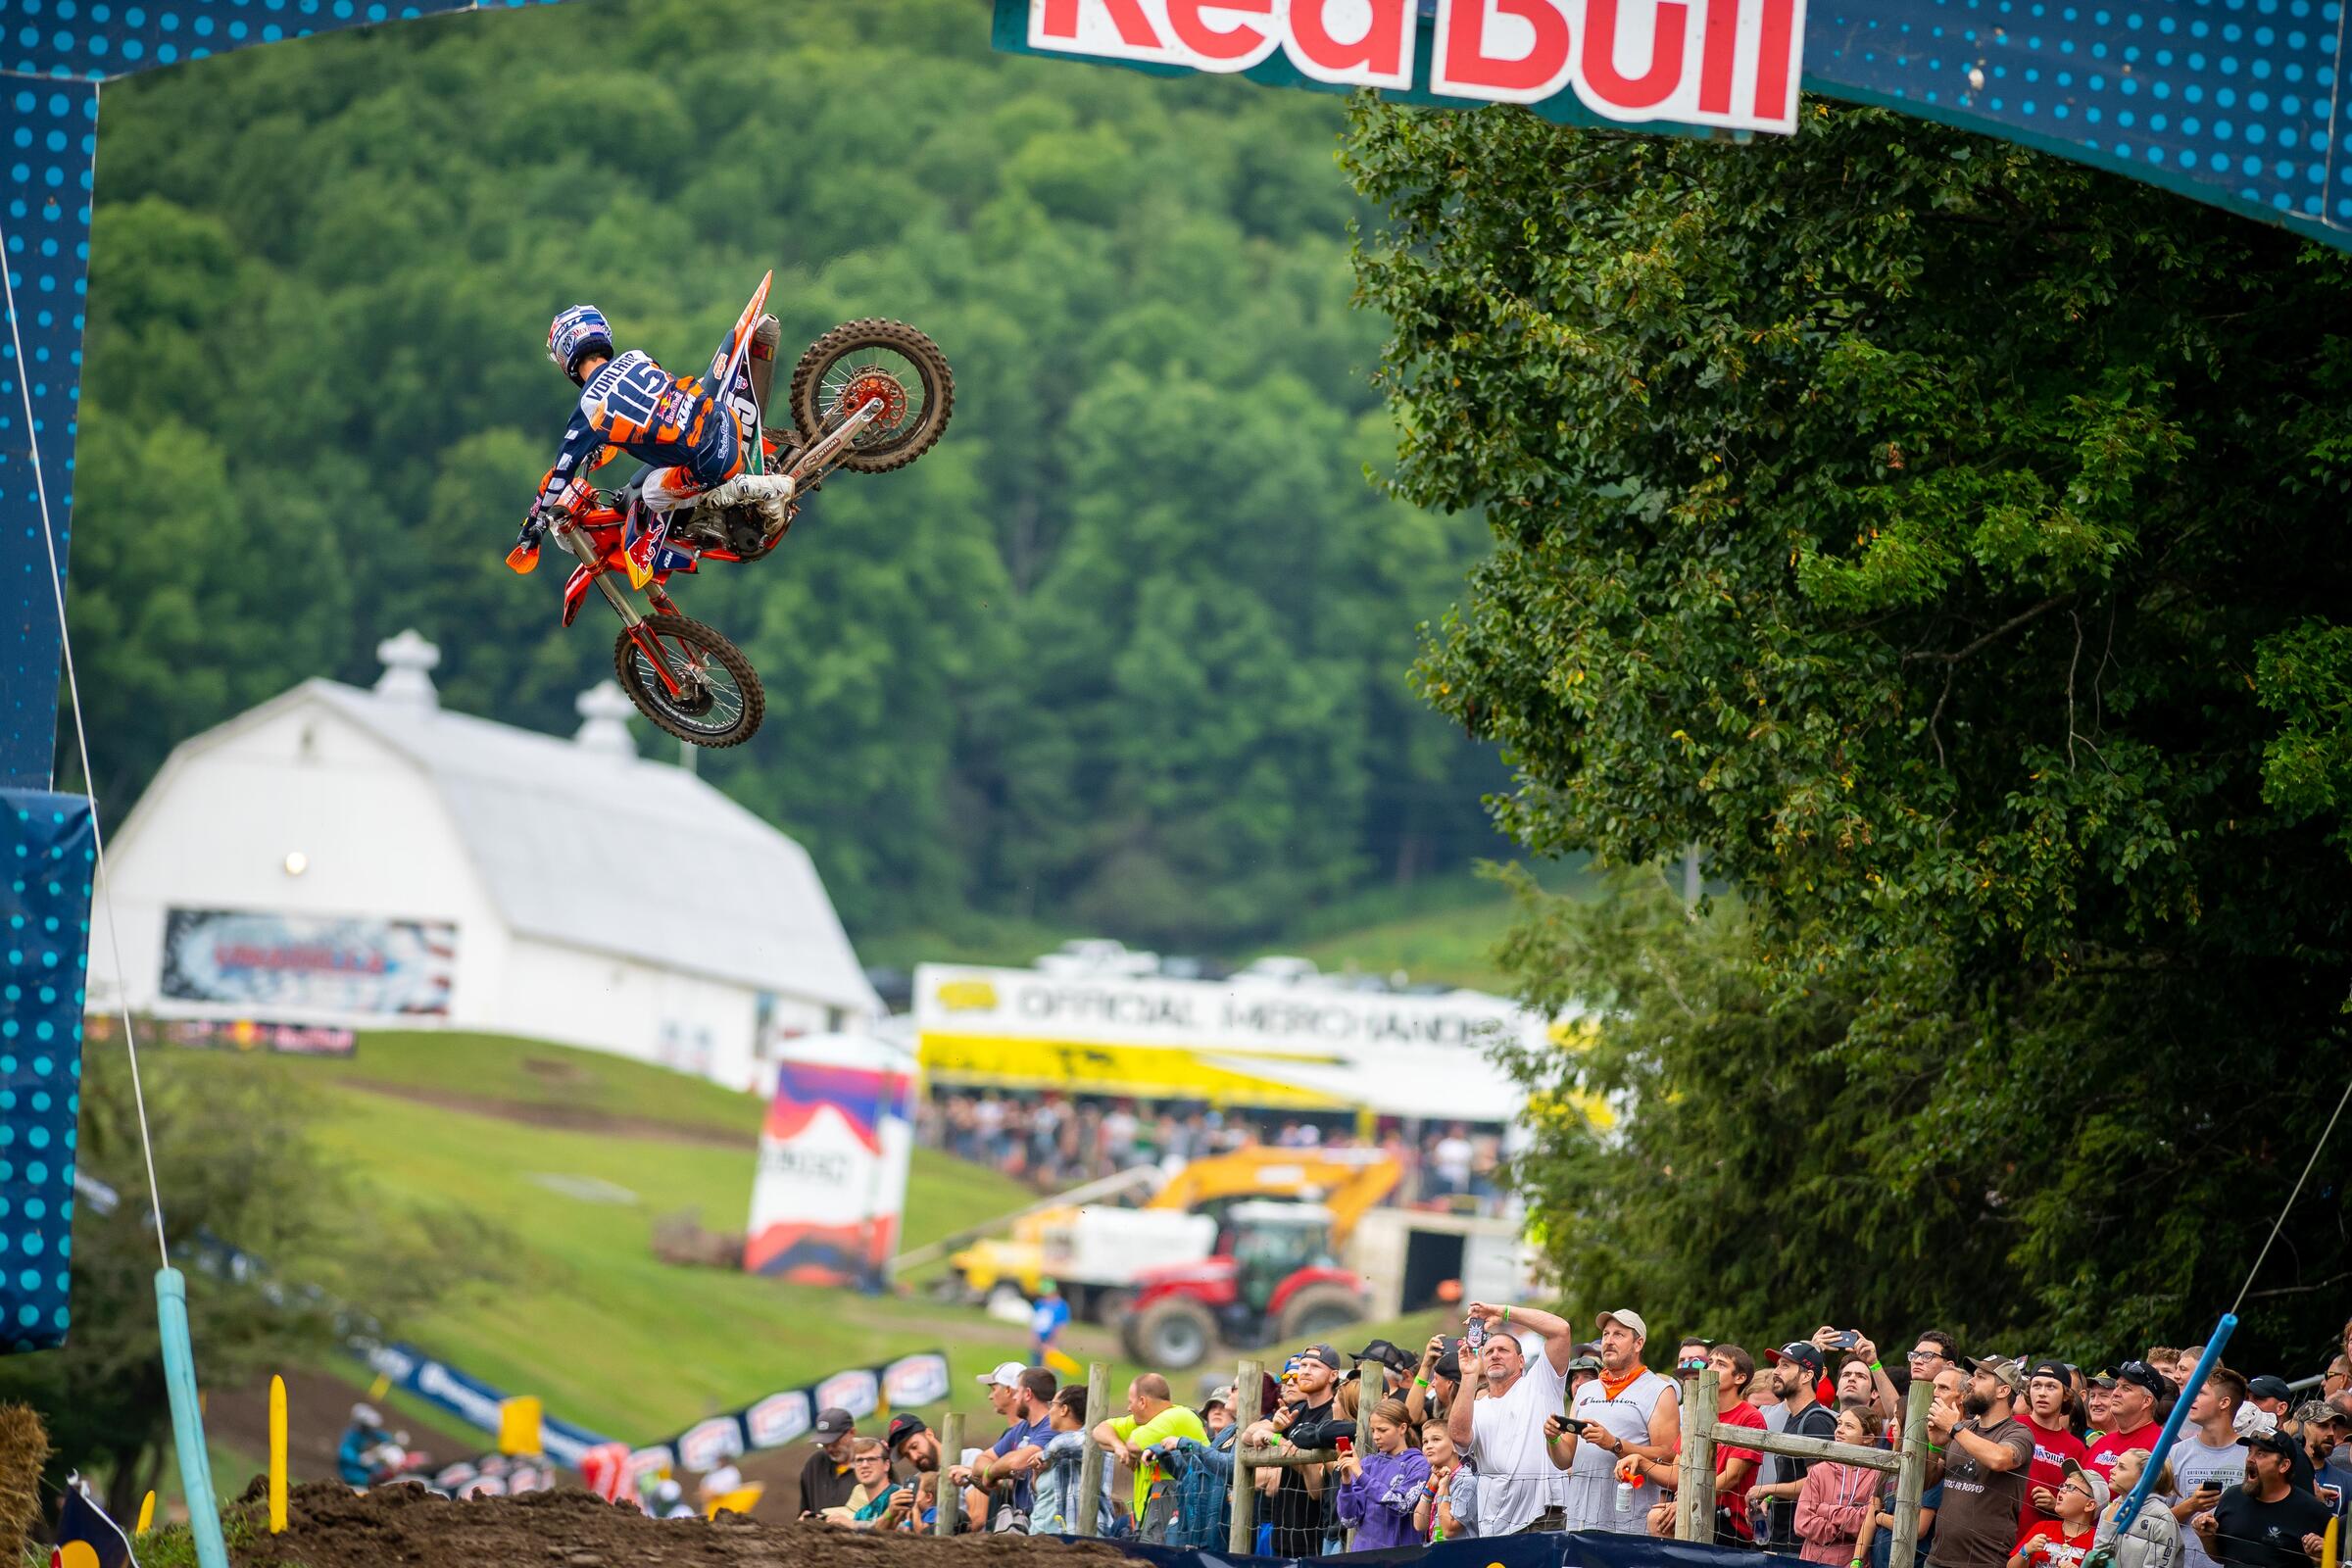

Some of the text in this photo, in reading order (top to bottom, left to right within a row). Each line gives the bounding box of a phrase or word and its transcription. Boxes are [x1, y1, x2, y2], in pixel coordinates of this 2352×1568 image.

[1043, 0, 1792, 120] ed Bull
[605, 361, 668, 428] 115
[676, 393, 697, 432] KTM
[1580, 1396, 1638, 1406] Champion
[2157, 1537, 2173, 1568] car
